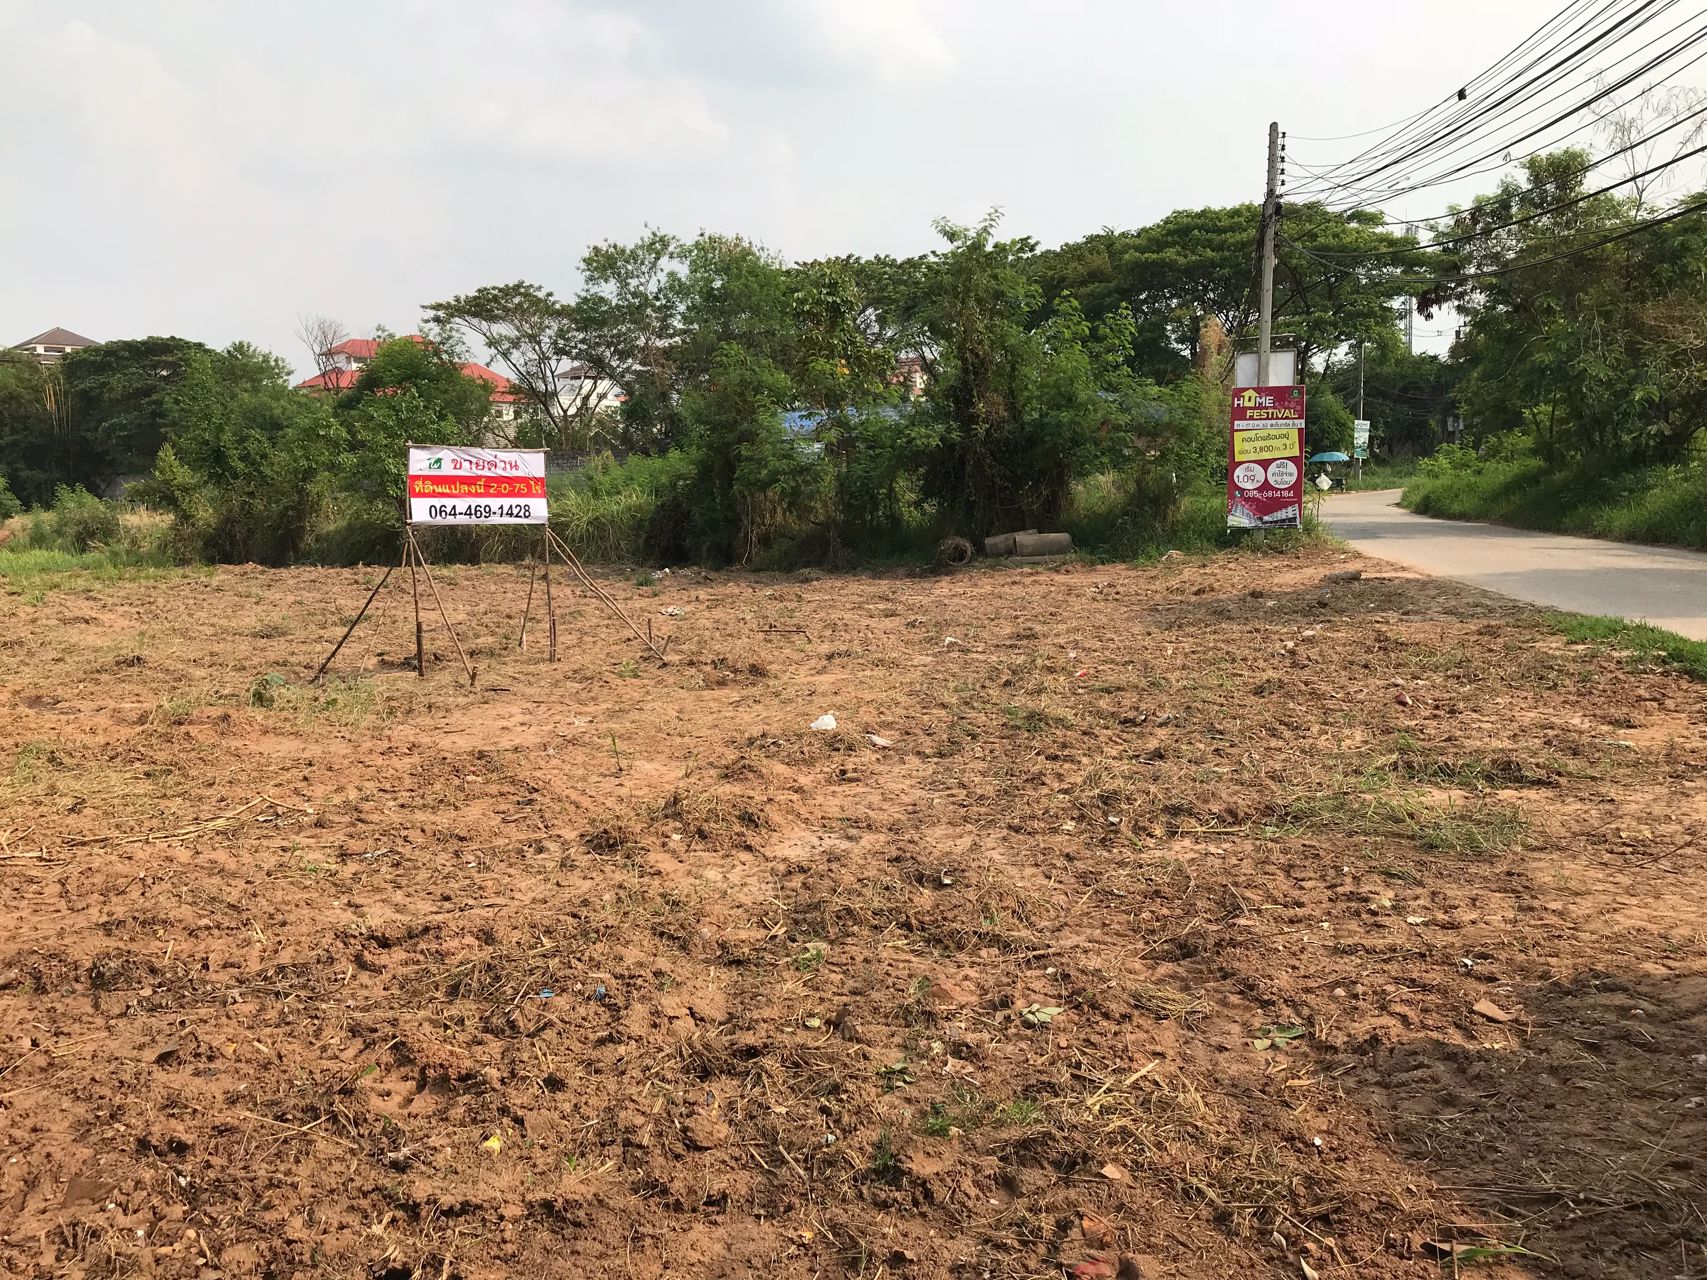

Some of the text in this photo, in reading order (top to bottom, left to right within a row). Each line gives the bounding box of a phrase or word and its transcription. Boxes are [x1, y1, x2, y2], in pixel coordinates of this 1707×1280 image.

[1234, 389, 1274, 407] HOME
[1246, 409, 1299, 419] FESTIVAL
[1242, 432, 1290, 443] คอนโดพร้อมอยู่
[451, 454, 520, 471] ขายด่วน
[414, 477, 542, 494] ที่ดินแปลงนี้ 2-0-75 ไร่
[428, 504, 532, 520] 064-469-1428
